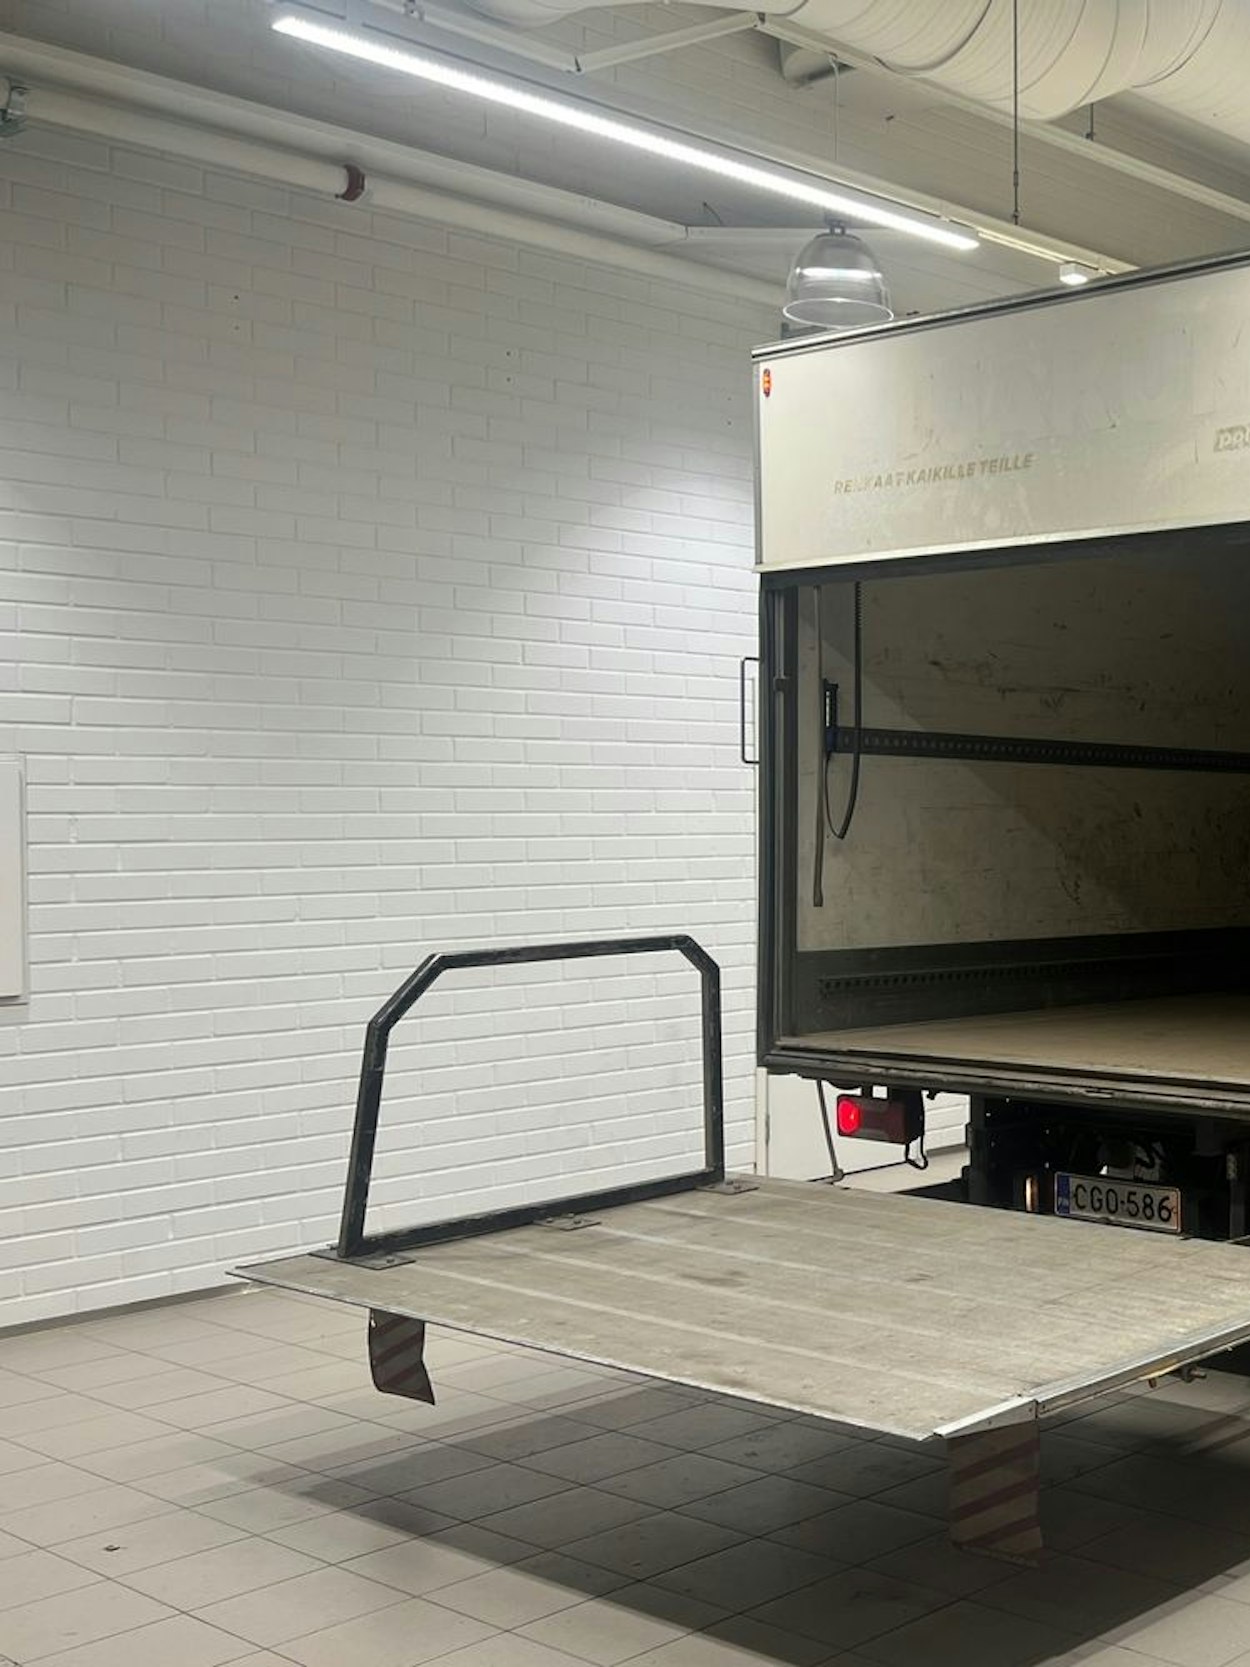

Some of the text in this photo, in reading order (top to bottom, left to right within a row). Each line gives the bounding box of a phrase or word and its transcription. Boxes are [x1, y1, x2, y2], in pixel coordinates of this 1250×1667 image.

[906, 461, 977, 486] KAIKILLE
[979, 452, 1035, 475] TEILLE
[1073, 1183, 1172, 1222] CGO-586
